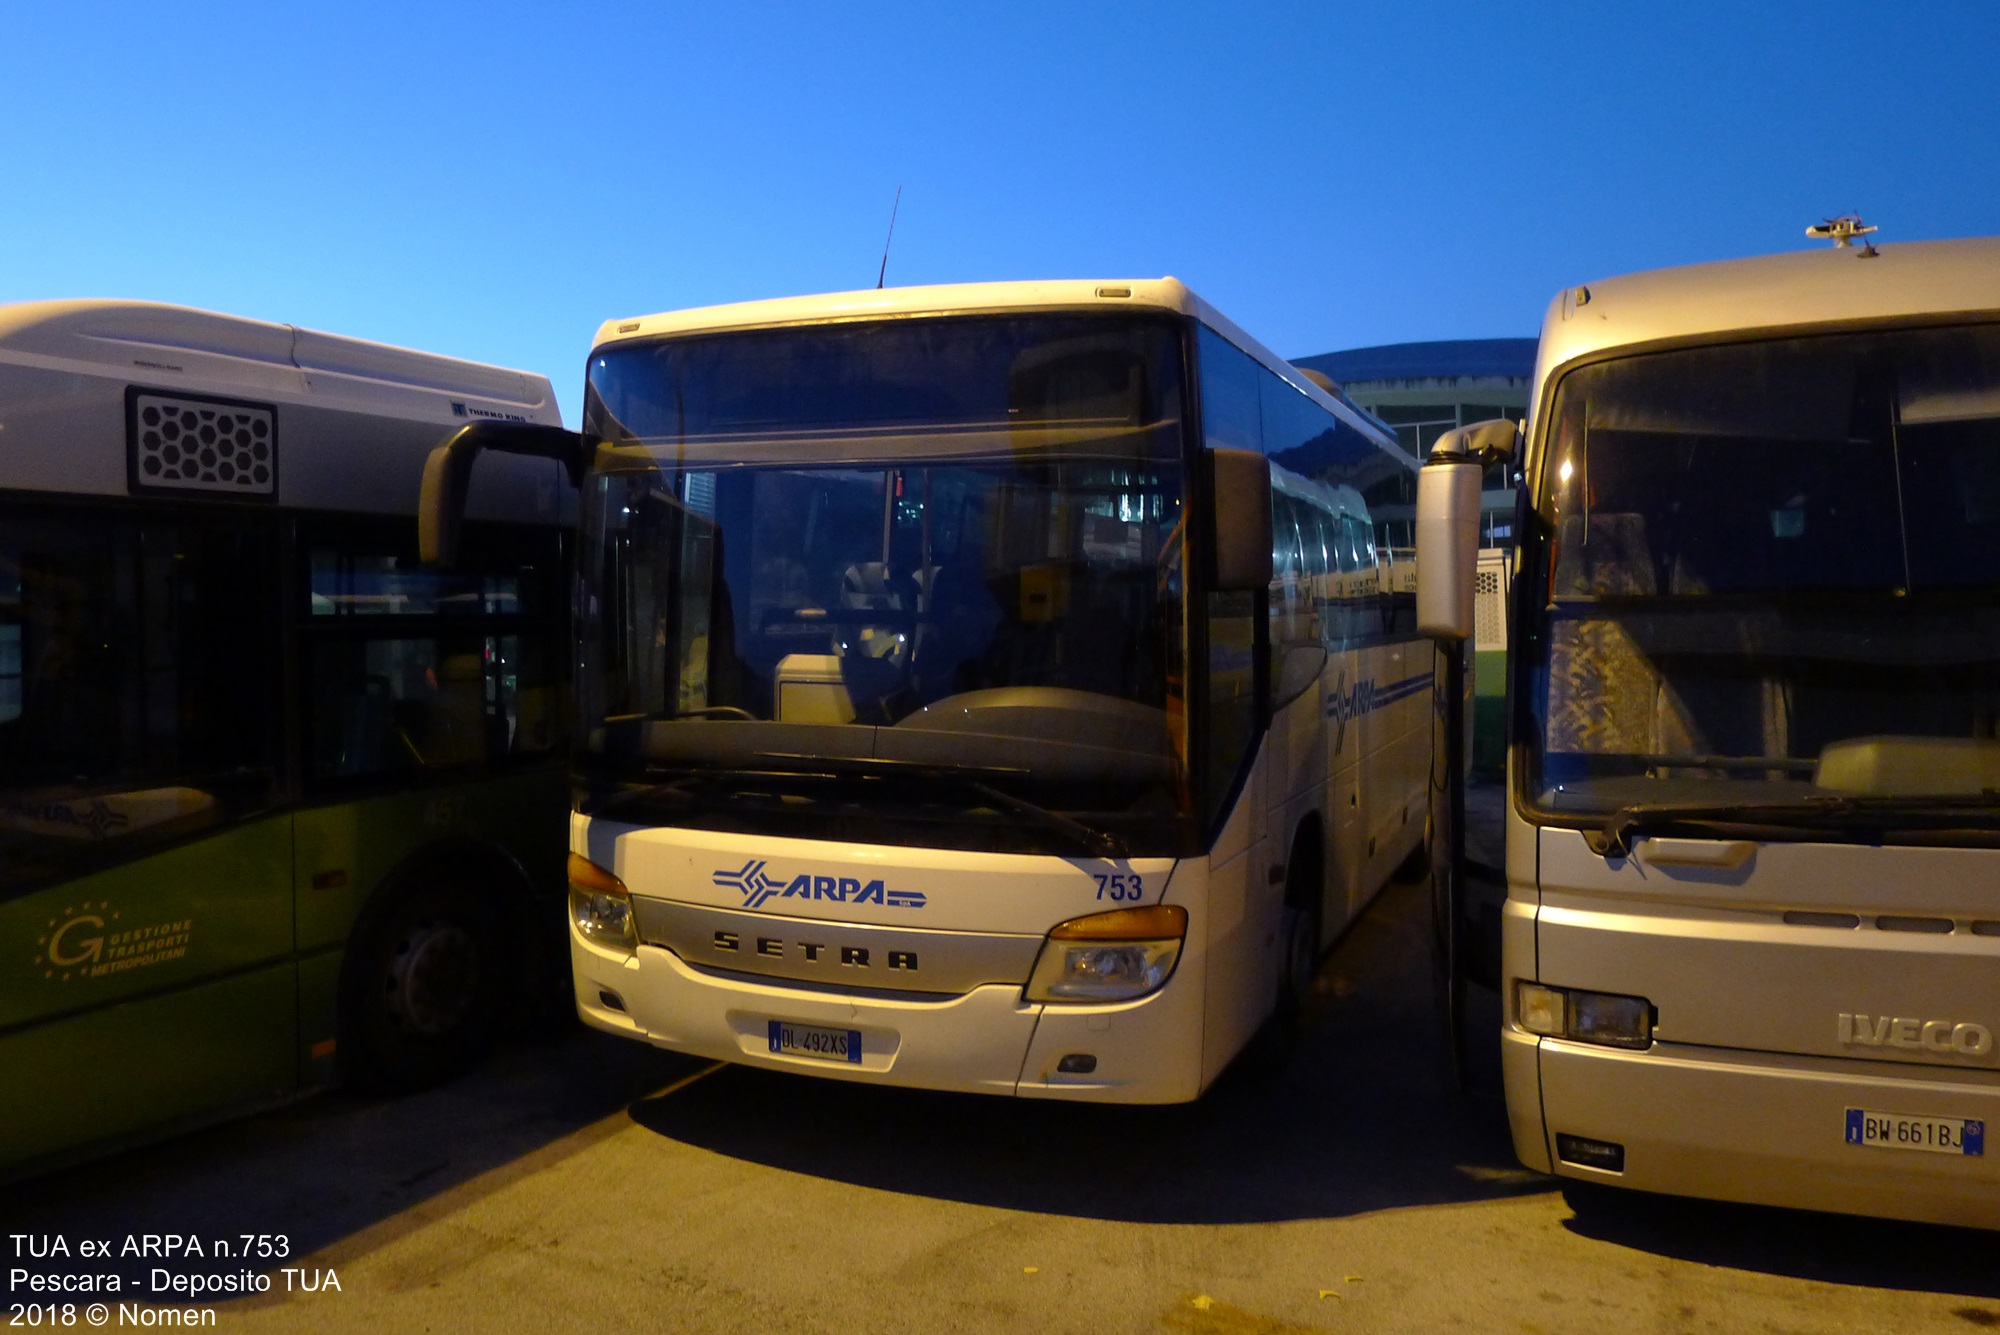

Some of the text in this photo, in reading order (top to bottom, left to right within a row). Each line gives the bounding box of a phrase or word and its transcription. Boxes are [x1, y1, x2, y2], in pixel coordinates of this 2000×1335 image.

[468, 408, 526, 423] THERMO KING
[781, 874, 884, 905] ARPA
[1093, 874, 1143, 901] 753
[108, 932, 189, 960] TRASPORTI
[111, 919, 192, 945] GESTIONE
[91, 946, 186, 977] METROPOLITANI
[715, 930, 918, 971] SETRA
[781, 1028, 799, 1050] DL
[803, 1032, 847, 1055] 492XS
[1838, 1013, 1993, 1055] IVECO
[1866, 1118, 1891, 1141] BW
[1898, 1121, 1963, 1148] 661BJ
